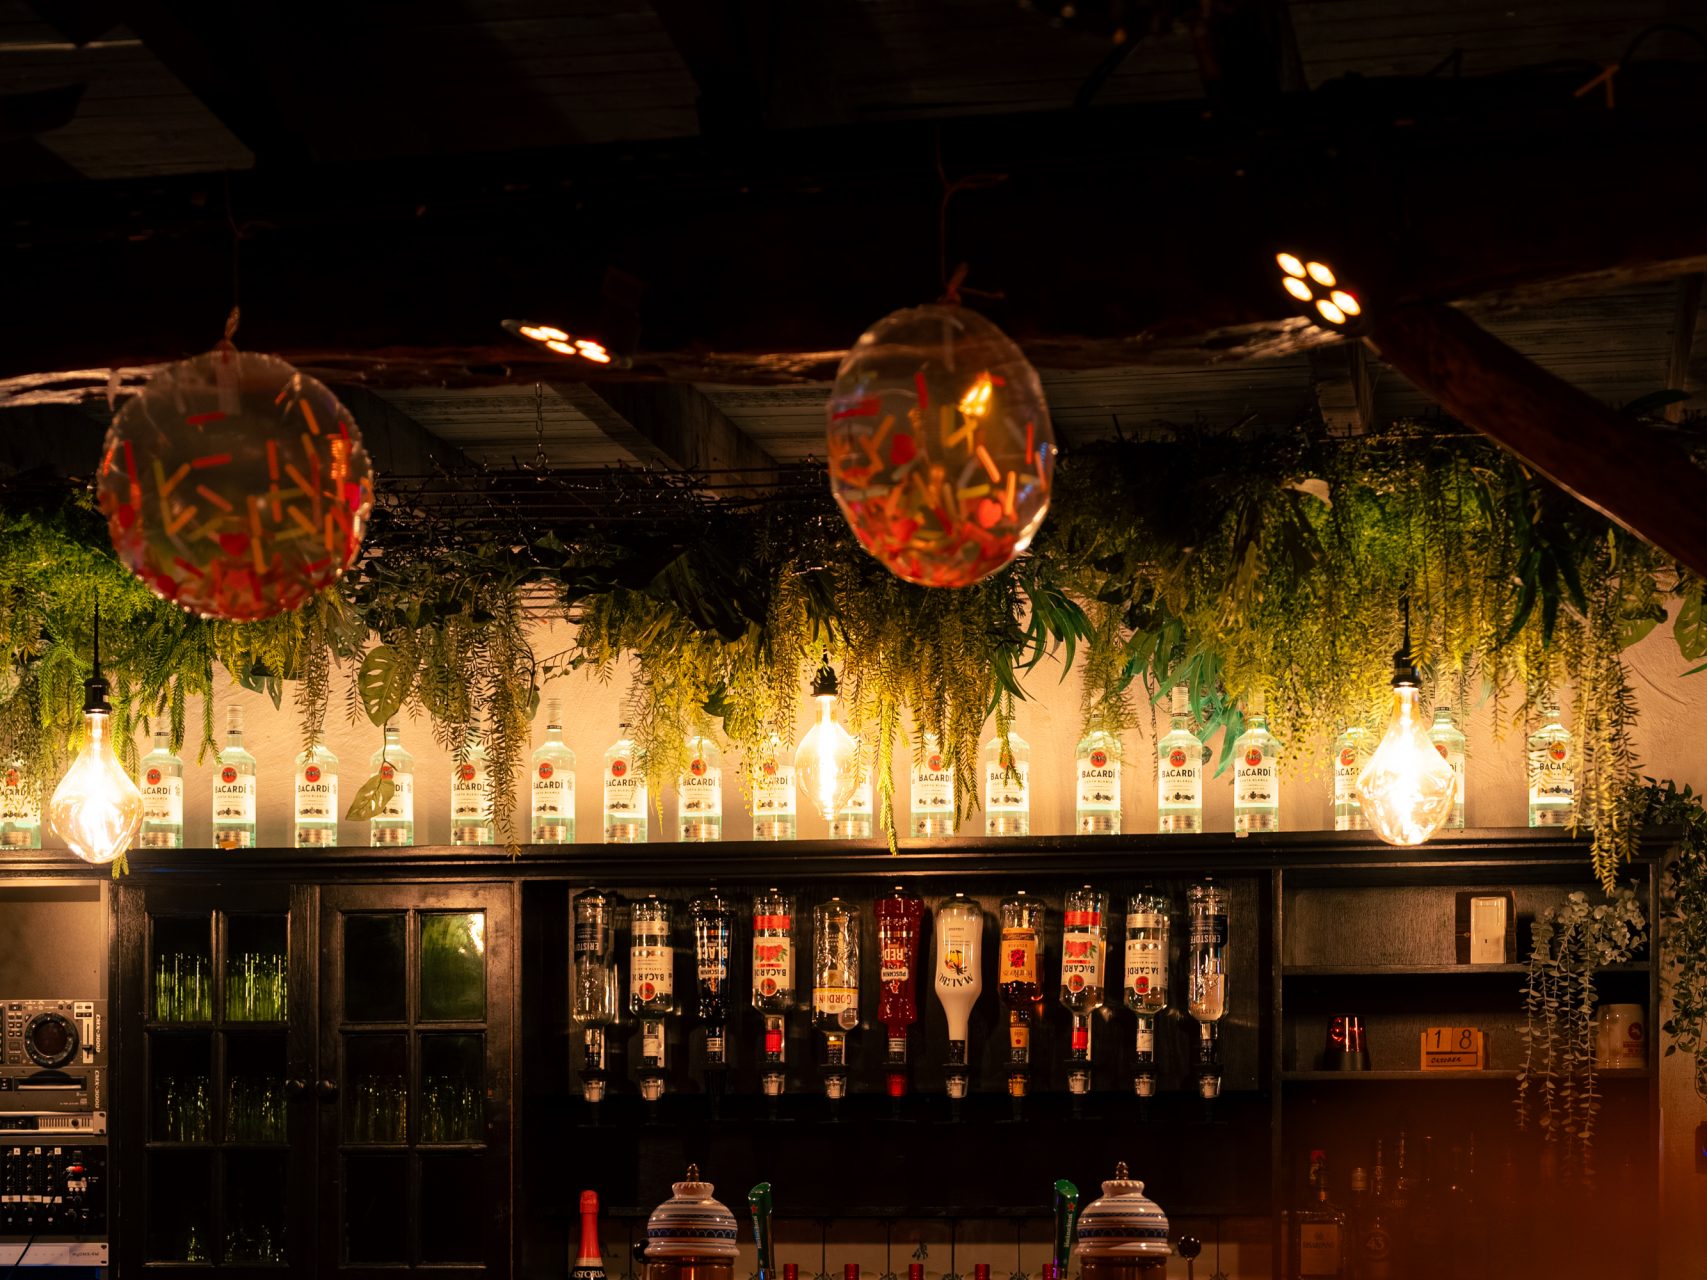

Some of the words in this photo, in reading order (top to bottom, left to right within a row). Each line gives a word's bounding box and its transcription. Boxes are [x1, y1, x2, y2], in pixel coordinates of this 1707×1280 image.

[884, 948, 904, 961] RED
[1435, 1029, 1441, 1049] 1
[1459, 1028, 1472, 1050] 8
[1366, 1237, 1384, 1250] 43
